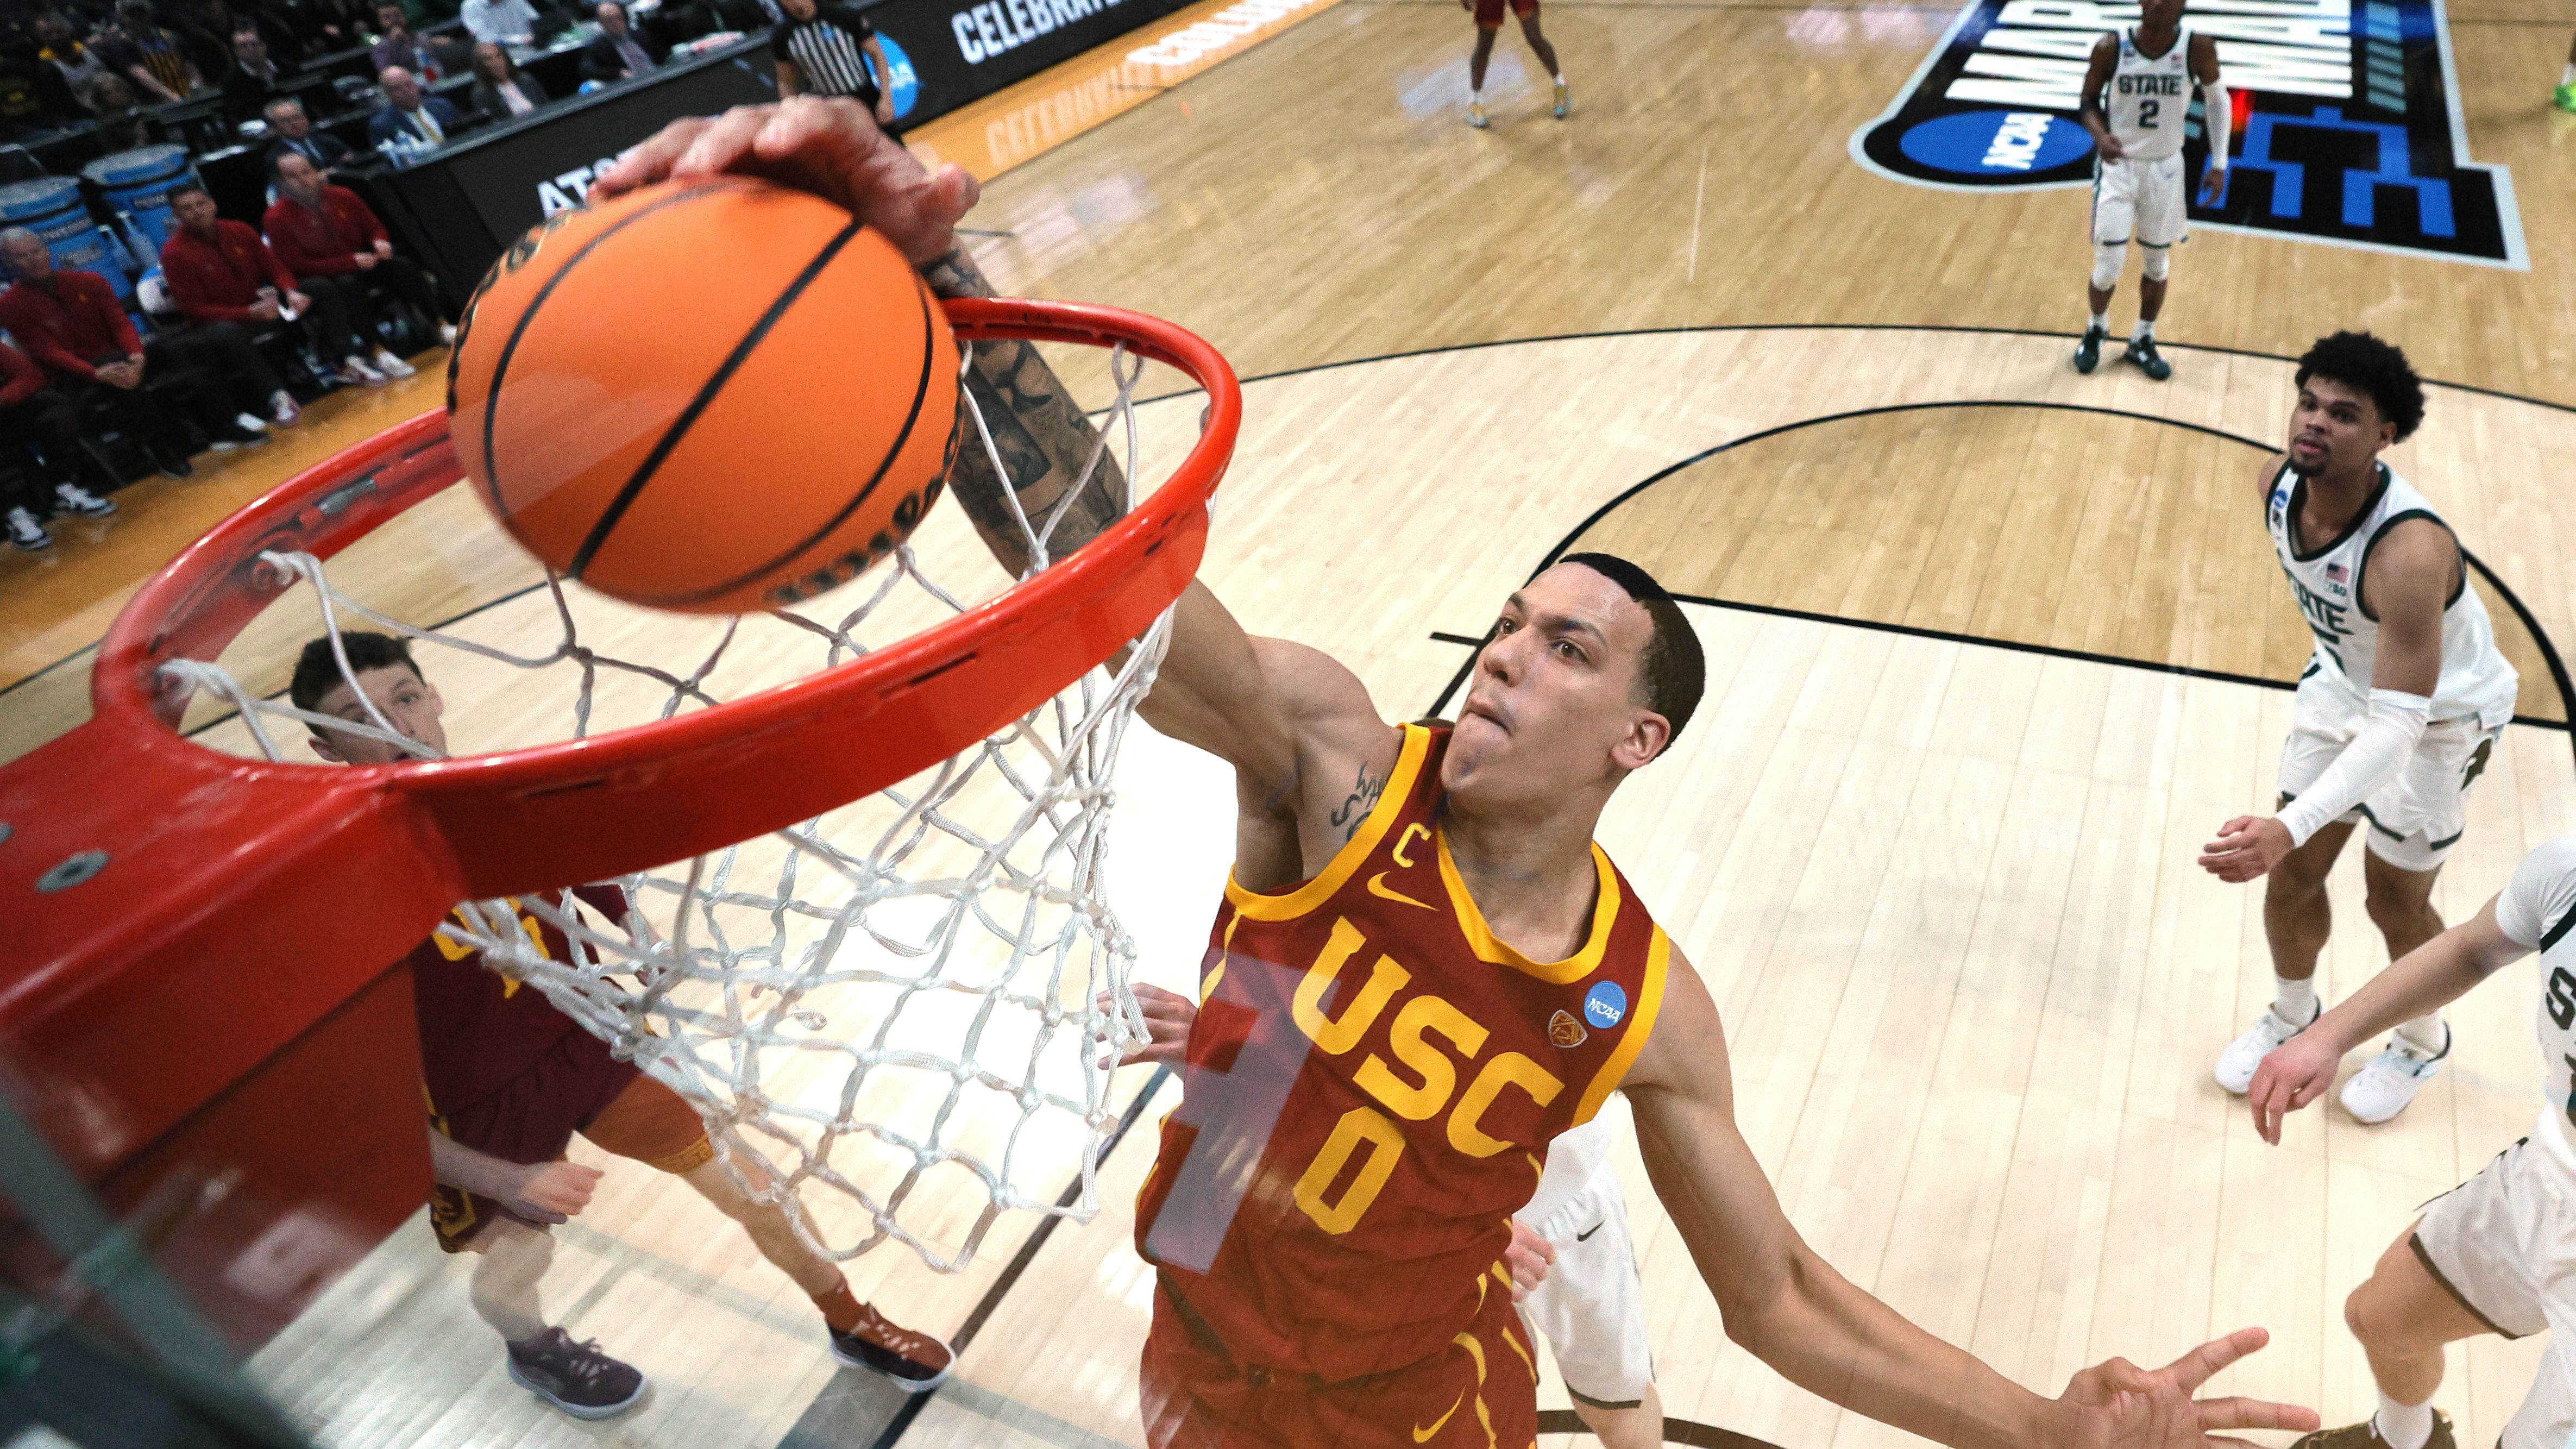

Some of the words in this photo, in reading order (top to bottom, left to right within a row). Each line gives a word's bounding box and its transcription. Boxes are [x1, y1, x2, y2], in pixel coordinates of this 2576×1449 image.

[2119, 74, 2183, 96] STATE
[2138, 100, 2159, 128] 2
[1982, 112, 2054, 170] NCAA
[1392, 822, 1432, 868] C
[1588, 998, 1622, 1023] NCAA
[1292, 916, 1565, 1158] USC
[1293, 1106, 1406, 1235] 0
